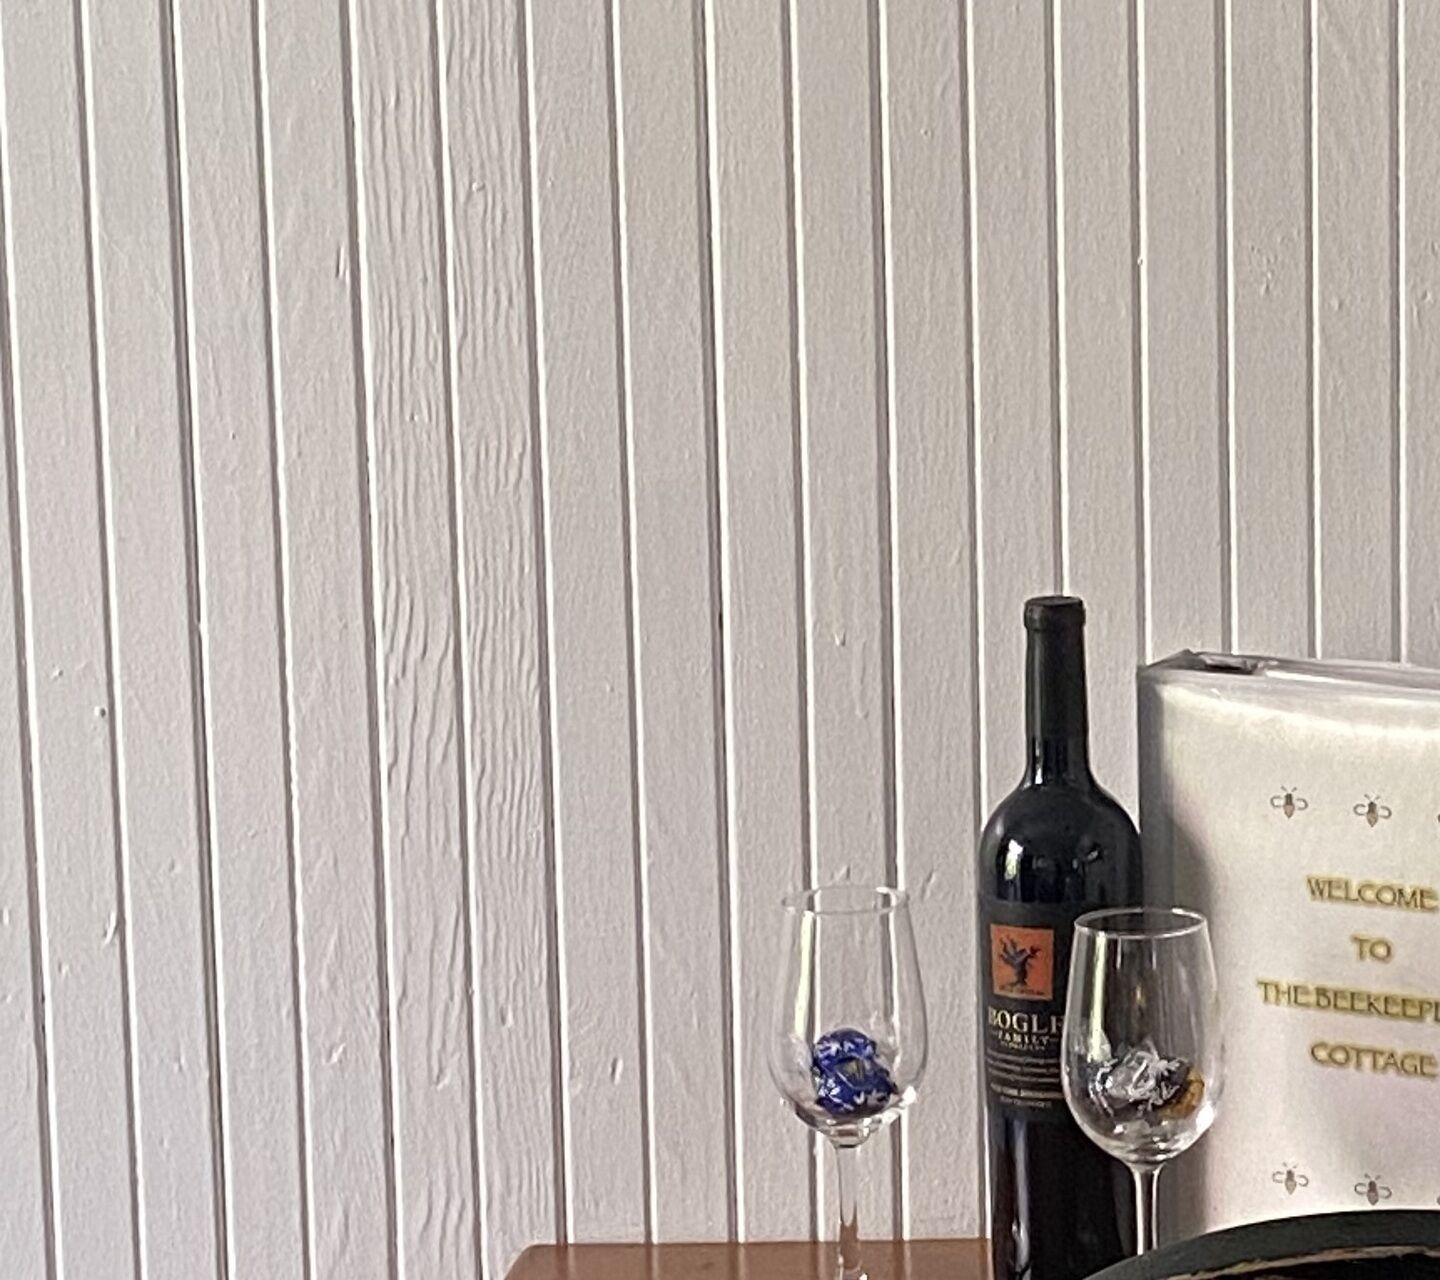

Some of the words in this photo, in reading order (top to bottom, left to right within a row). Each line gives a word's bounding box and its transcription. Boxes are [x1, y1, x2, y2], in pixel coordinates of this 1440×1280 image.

[1306, 876, 1439, 913] WELCOME
[1352, 934, 1392, 963] TO
[1256, 978, 1311, 1008] THE
[1309, 1040, 1439, 1079] COTTAGE
